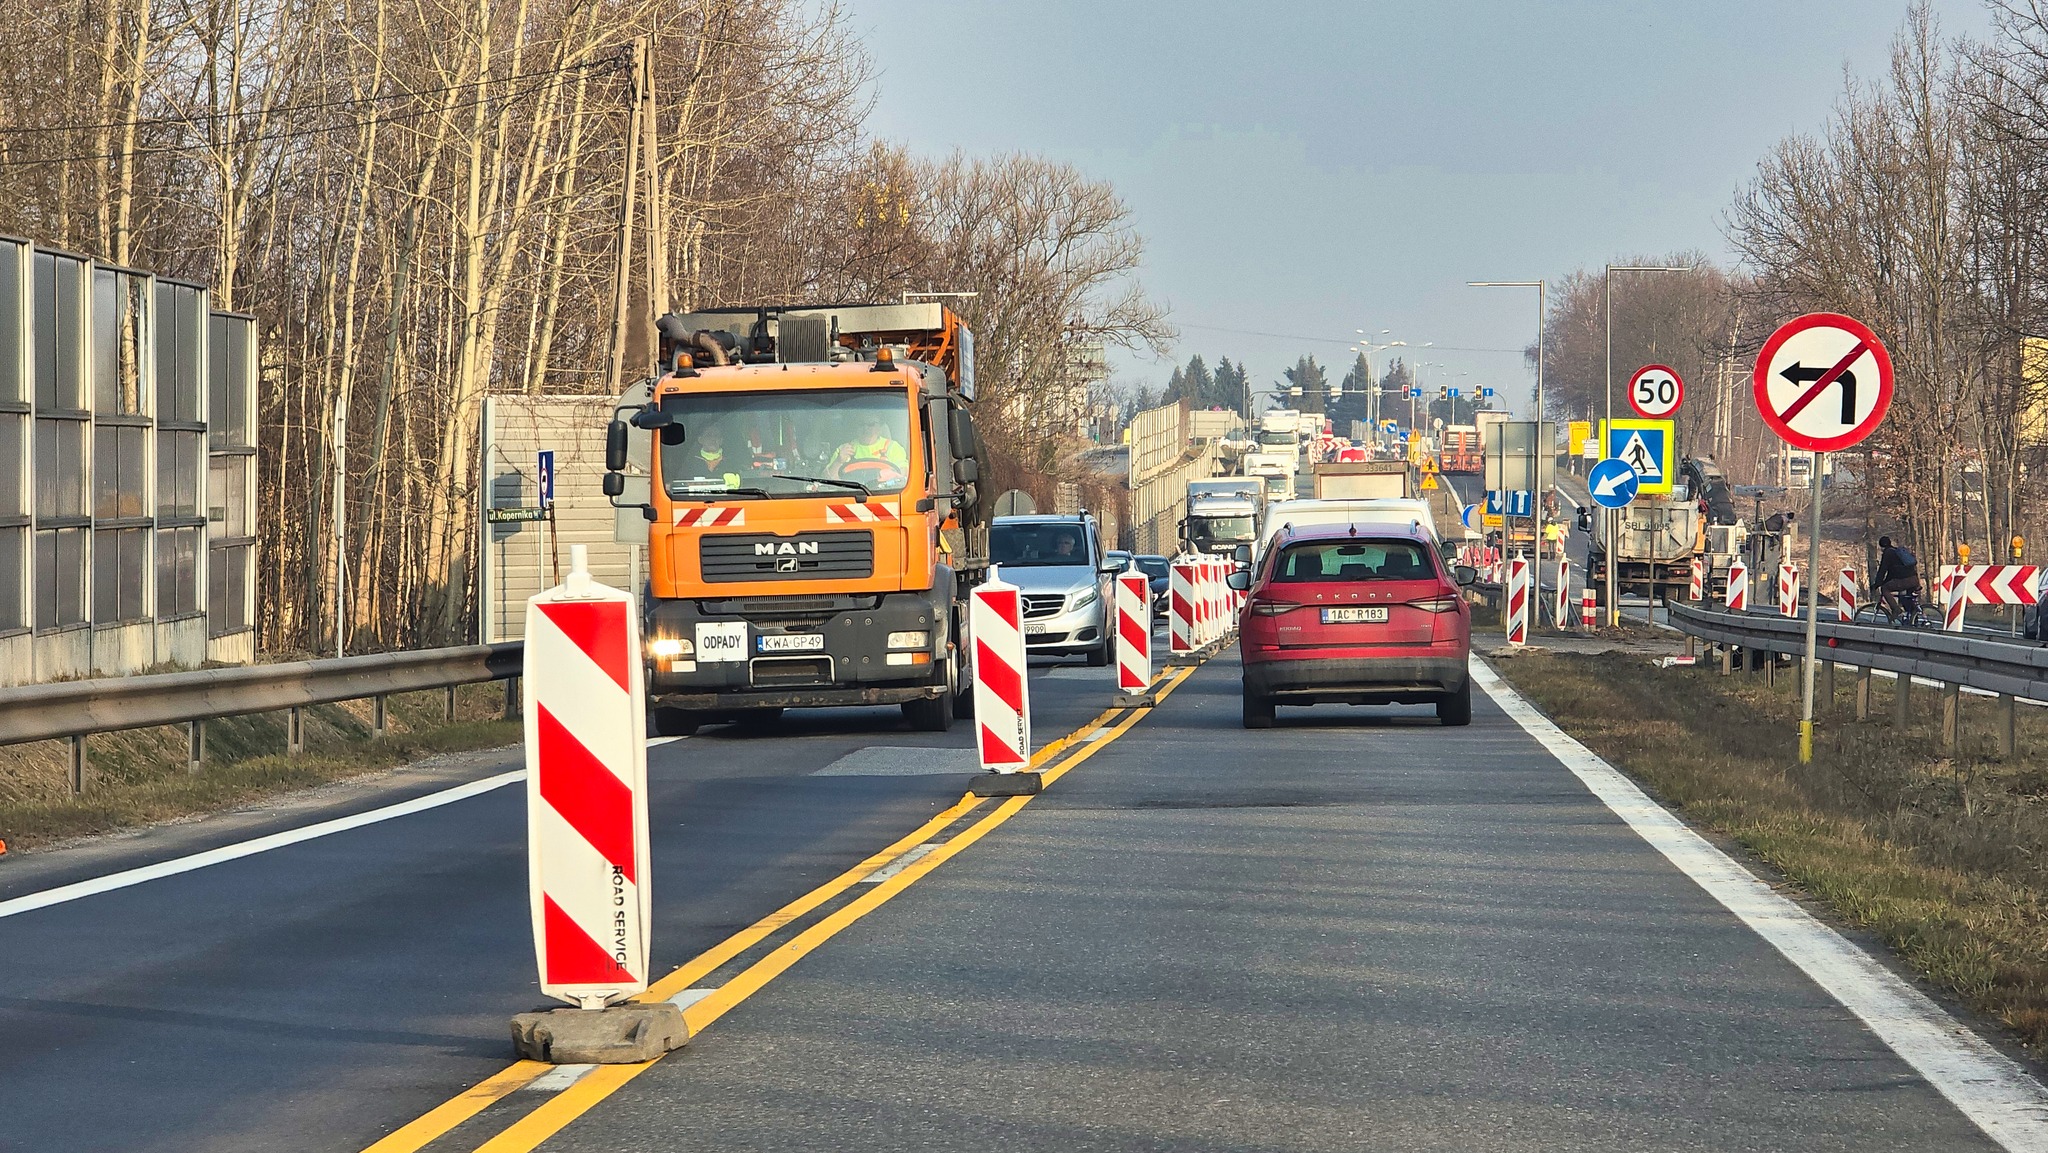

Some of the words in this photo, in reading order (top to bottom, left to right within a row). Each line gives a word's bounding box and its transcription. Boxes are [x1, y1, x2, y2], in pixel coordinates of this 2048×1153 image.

[1638, 379, 1675, 404] 50
[1365, 464, 1392, 472] 333641
[1645, 522, 1670, 531] 9095
[755, 542, 819, 555] MAN
[1331, 610, 1350, 619] 1AC
[1357, 609, 1383, 619] R183
[1024, 626, 1044, 634] 9909
[704, 634, 741, 649] ODPADY
[765, 637, 789, 649] KWA
[793, 636, 821, 648] GP49
[612, 865, 624, 906] ROAD
[614, 910, 627, 970] SERVICE
